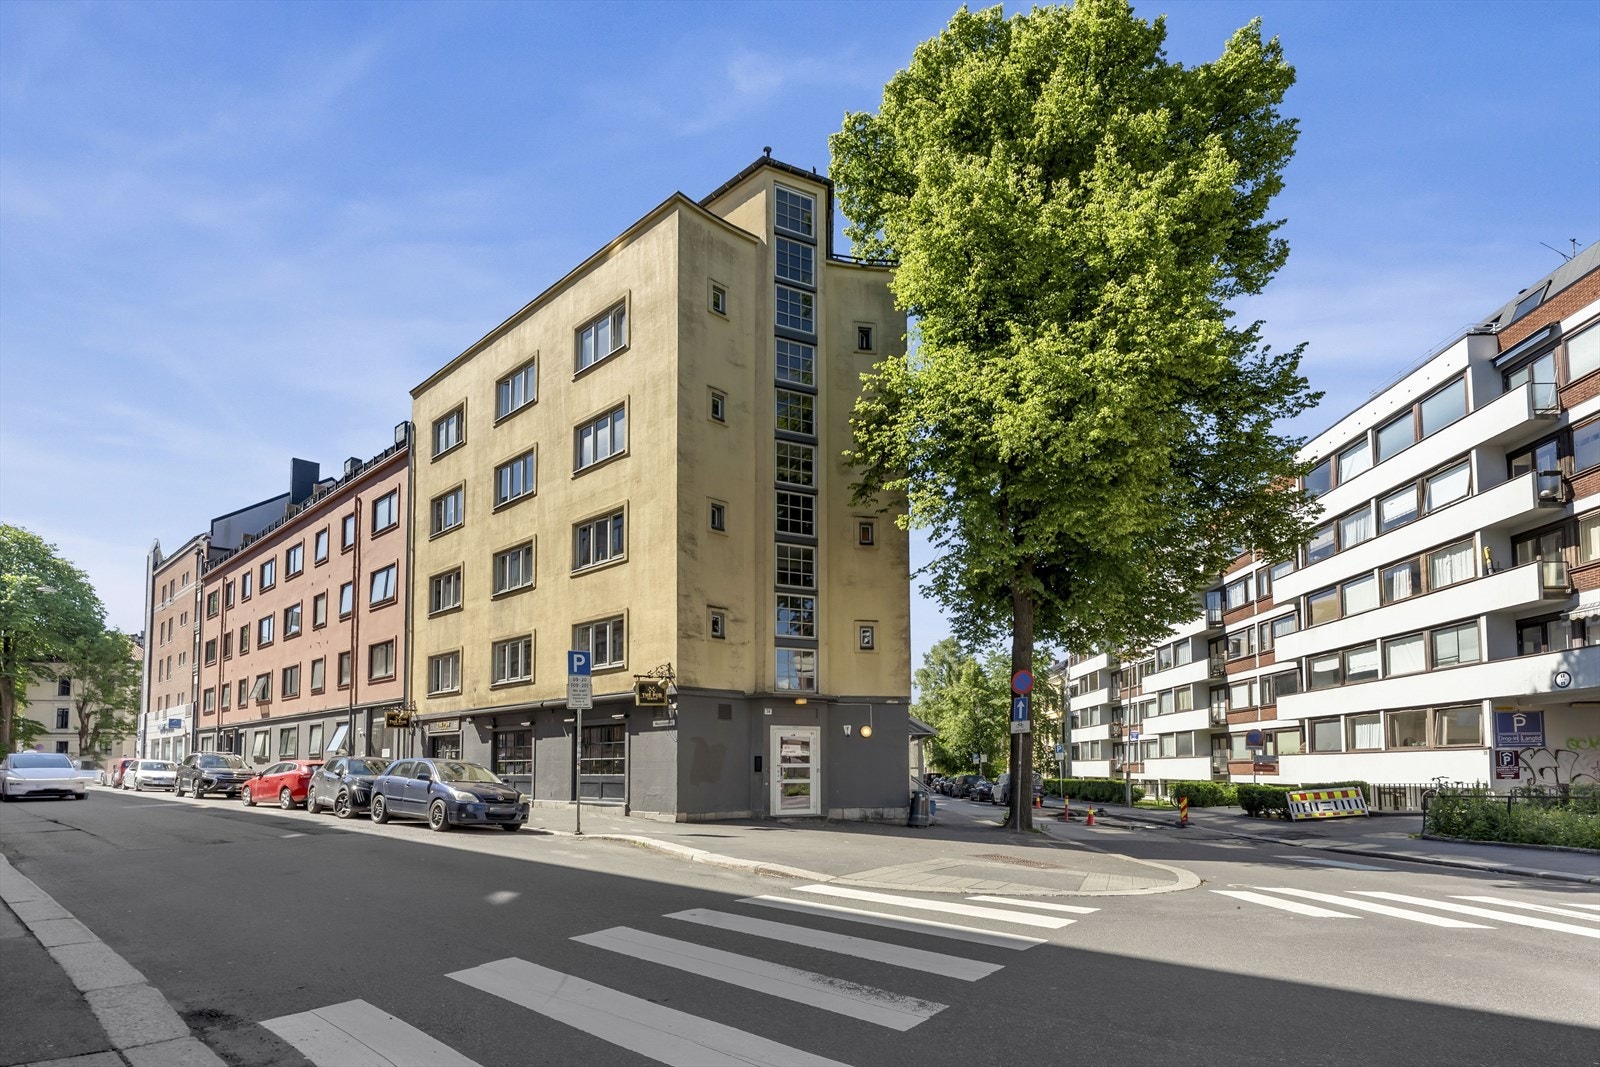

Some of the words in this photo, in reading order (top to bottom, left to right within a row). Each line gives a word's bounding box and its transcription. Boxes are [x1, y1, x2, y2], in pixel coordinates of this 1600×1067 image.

[573, 654, 586, 673] P
[1513, 716, 1527, 733] P
[1503, 756, 1511, 766] P
